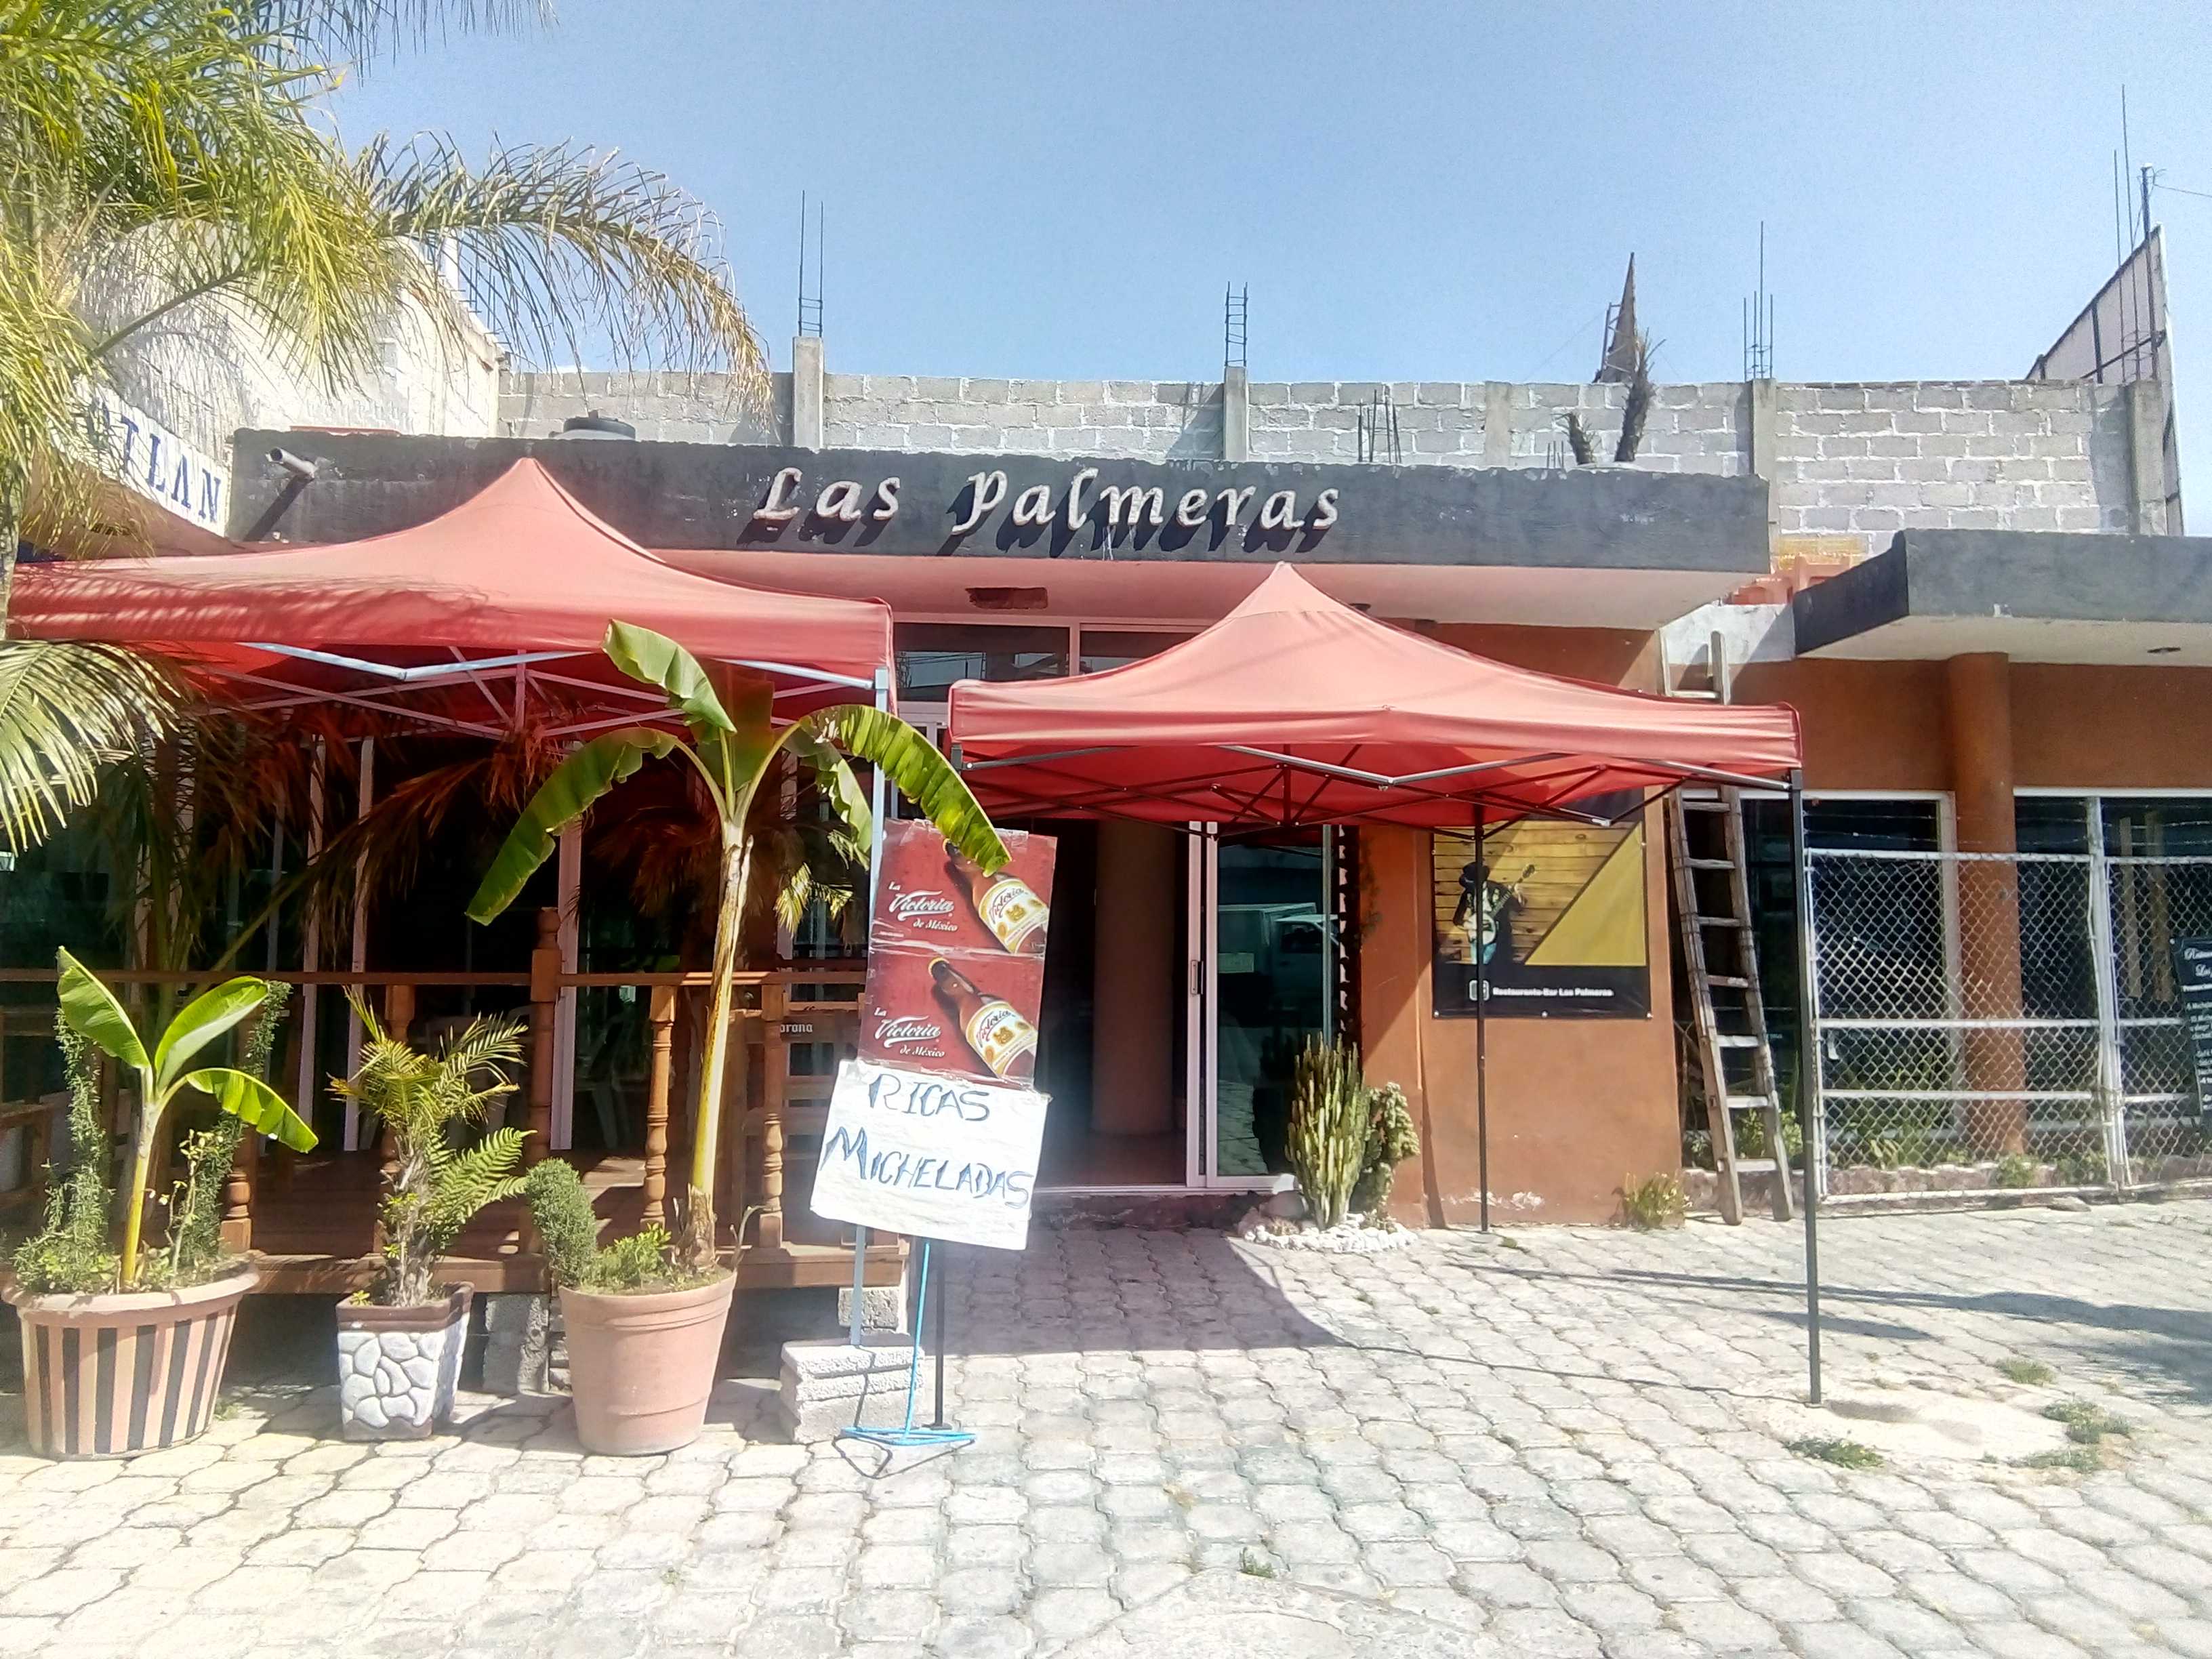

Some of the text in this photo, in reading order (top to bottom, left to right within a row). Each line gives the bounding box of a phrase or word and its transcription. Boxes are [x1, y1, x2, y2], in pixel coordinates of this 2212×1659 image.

[752, 467, 1340, 534] Las Palmeras
[888, 881, 901, 890] La
[888, 890, 955, 921] Victoria
[913, 917, 958, 932] de México
[1559, 987, 1574, 996] Las
[1574, 987, 1614, 997] Palmeras
[874, 1007, 887, 1017] La
[779, 1023, 813, 1033] orona
[875, 1015, 941, 1048] Victoria
[899, 1044, 945, 1057] de México
[868, 1073, 990, 1122] RICAS
[819, 1126, 1034, 1210] MICHELADAS
